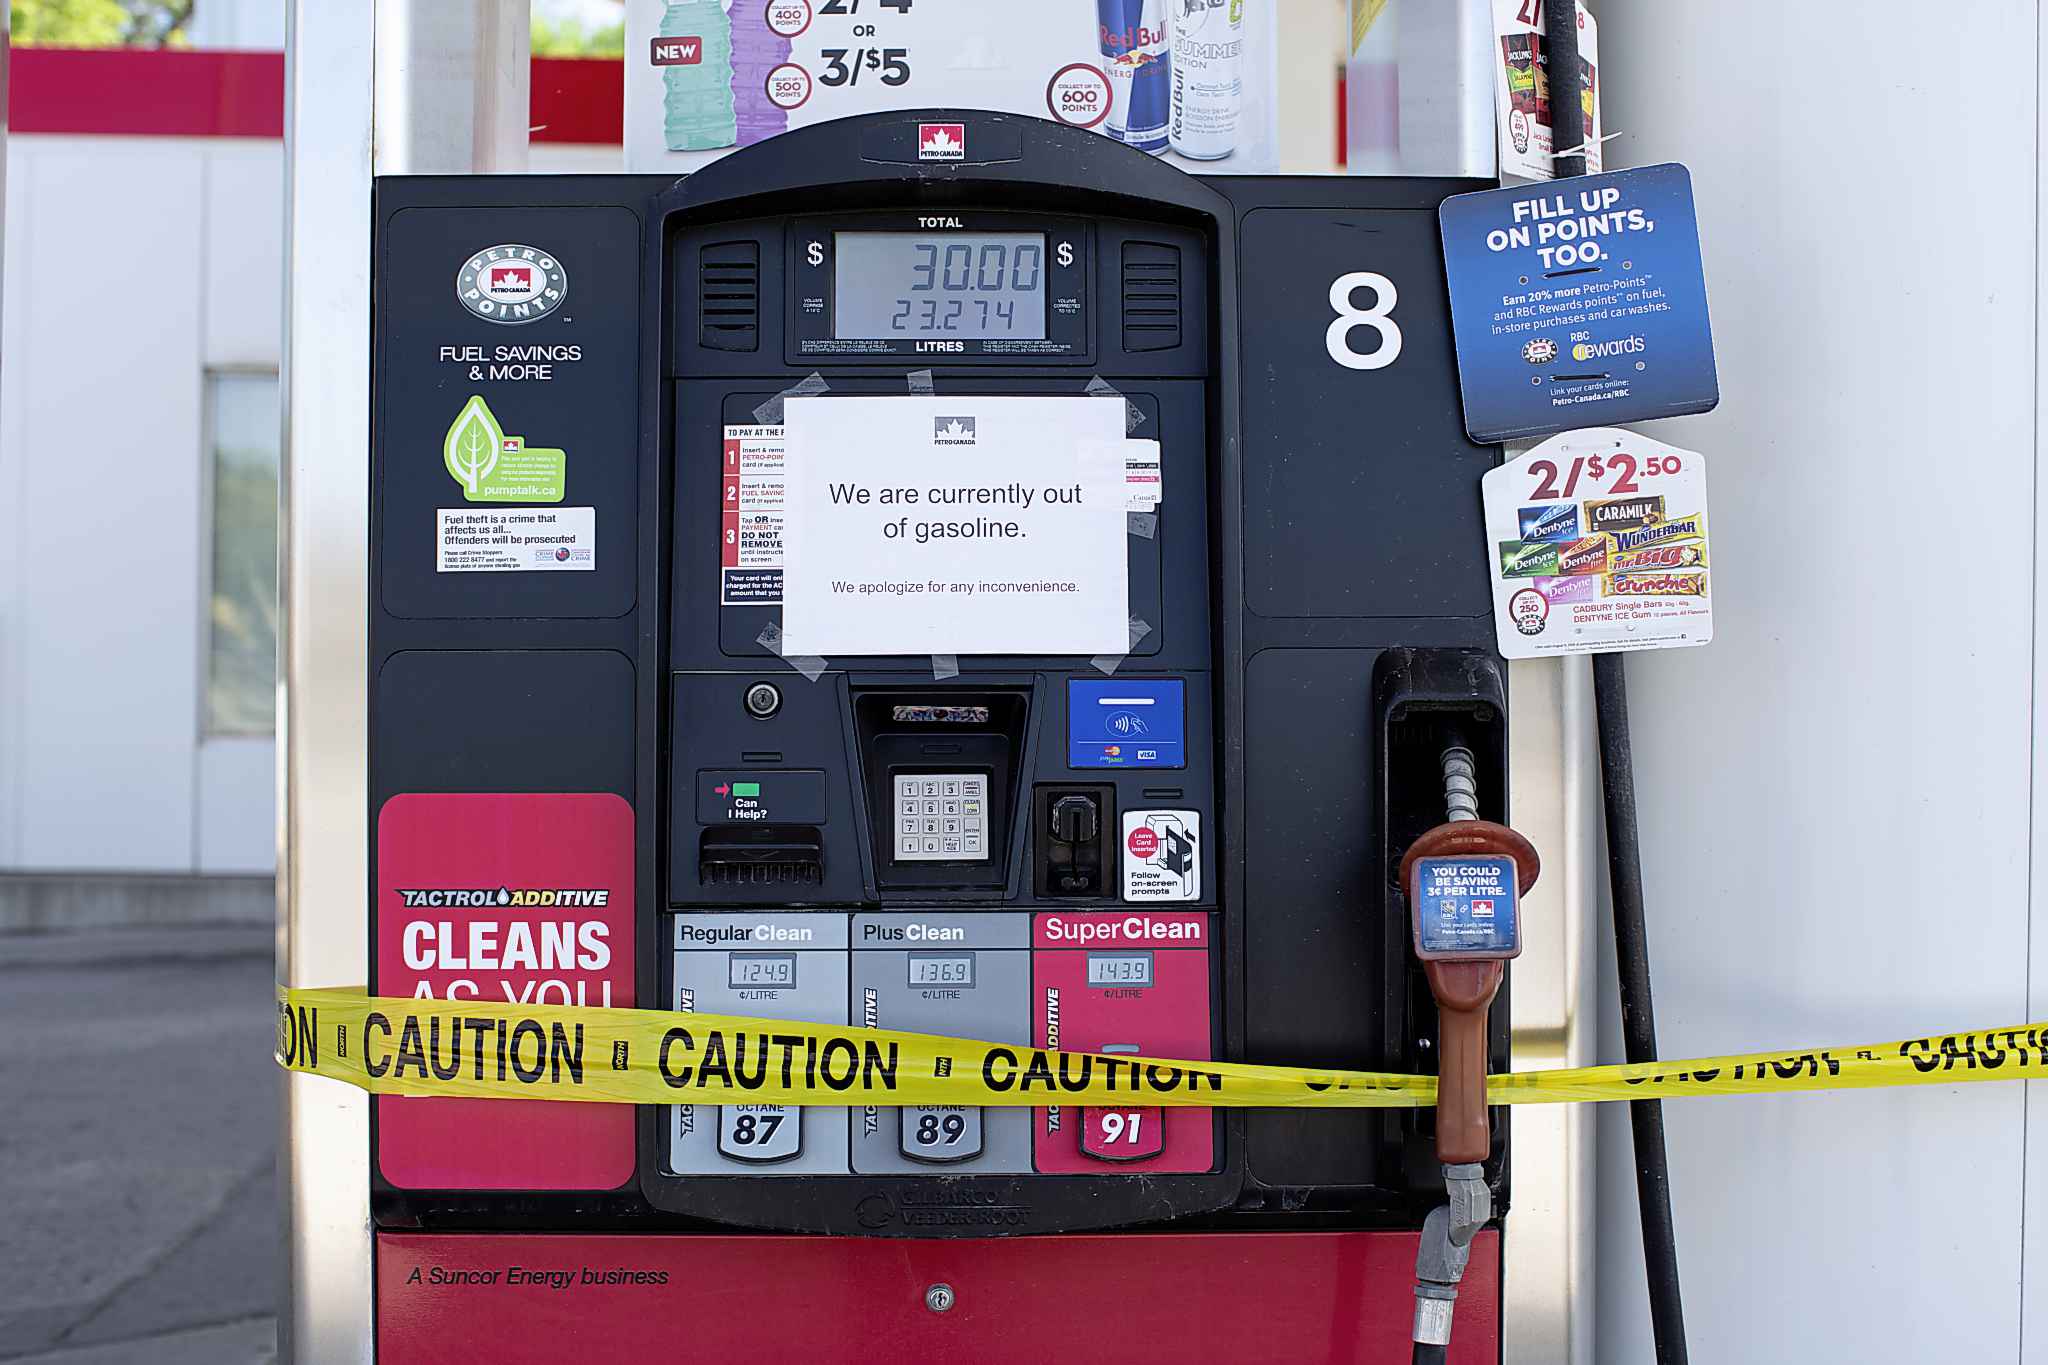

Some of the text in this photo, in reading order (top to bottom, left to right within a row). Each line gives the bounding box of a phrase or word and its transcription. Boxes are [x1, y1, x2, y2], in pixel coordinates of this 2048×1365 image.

[776, 10, 801, 19] 400
[853, 25, 876, 37] OR
[656, 44, 697, 60] NEW
[818, 47, 910, 87] 3/$5
[776, 82, 801, 91] 500
[1062, 91, 1097, 102] 600
[1512, 188, 1620, 223] FILL UP
[918, 217, 964, 228] TOTAL
[1486, 208, 1654, 252] ON POINTS,
[470, 248, 554, 271] PETRO
[808, 241, 824, 267] $
[1057, 241, 1073, 267] $
[1536, 241, 1608, 269] TOO.
[912, 244, 1040, 291] 30.00
[464, 288, 559, 318] POINTS
[1494, 311, 1513, 321] and
[1516, 306, 1536, 318] RBC
[1539, 299, 1581, 314] Rewards
[1626, 292, 1639, 302] on
[1642, 288, 1665, 299] fuel,
[1502, 295, 1525, 306] Earn
[1528, 292, 1552, 302] 20%
[1554, 288, 1580, 298] more
[892, 300, 1014, 330] 23.274
[1326, 271, 1401, 370] 8
[1492, 301, 1671, 335] in-store purchases and car washes.
[1570, 331, 1590, 342] RBC
[440, 346, 582, 361] FUEL SAVINGS
[916, 342, 964, 352] LITRES
[469, 365, 552, 380] & MORE
[1550, 383, 1603, 396] Link your cards
[1552, 389, 1630, 406] Petro-Canada.ca/RBC
[728, 450, 734, 464] 1
[1527, 454, 1682, 500] 2/$2.50
[484, 486, 556, 497] pumptalk.ca
[727, 486, 736, 500] 2
[829, 482, 1082, 509] We are currently out
[445, 516, 464, 524] Fuel
[466, 515, 488, 524] theft
[490, 515, 498, 524] is
[509, 515, 535, 524] crime
[538, 514, 556, 523] that
[1596, 504, 1653, 521] CARAMILK
[444, 526, 476, 534] affects
[492, 525, 511, 534] all...
[883, 517, 1026, 543] of gasoline.
[1534, 518, 1575, 537] Dentyne
[445, 534, 576, 546] Offenders will be prosecuted
[726, 529, 735, 544] 3
[1514, 551, 1556, 570] Dentyne
[1563, 550, 1604, 570] Dentyne
[832, 579, 1080, 596] We apologize for any inconvenience.
[1520, 604, 1539, 612] 250
[1573, 604, 1612, 614] CADBURY
[1615, 602, 1641, 611] Single
[1574, 613, 1613, 623] DENTYNE
[1615, 612, 1629, 620] ICE
[1631, 611, 1651, 619] Gum
[735, 798, 758, 808] Can
[735, 809, 767, 820] Help?
[1432, 867, 1500, 876] YOU COULD
[1435, 877, 1498, 886] BE SAVING
[402, 890, 608, 906] TACTROL ADDITIVE
[1132, 888, 1170, 896] prompts
[1427, 887, 1506, 896] 3¢ PER LITRE.
[402, 921, 611, 970] CLEANS
[742, 962, 788, 981] 124.9
[920, 962, 965, 981] 136.9
[1100, 962, 1144, 980] 143.9
[739, 991, 778, 1000] ¢/LITRE
[922, 991, 960, 999] ¢/LITRE
[364, 1012, 584, 1084] CAUTION
[659, 1027, 898, 1091] CAUTION
[982, 1048, 1222, 1092] CAUTION
[733, 1115, 784, 1145] 87
[916, 1114, 968, 1145] 89
[1102, 1113, 1141, 1144] 91
[406, 1266, 670, 1290] A Suncor Energy business
